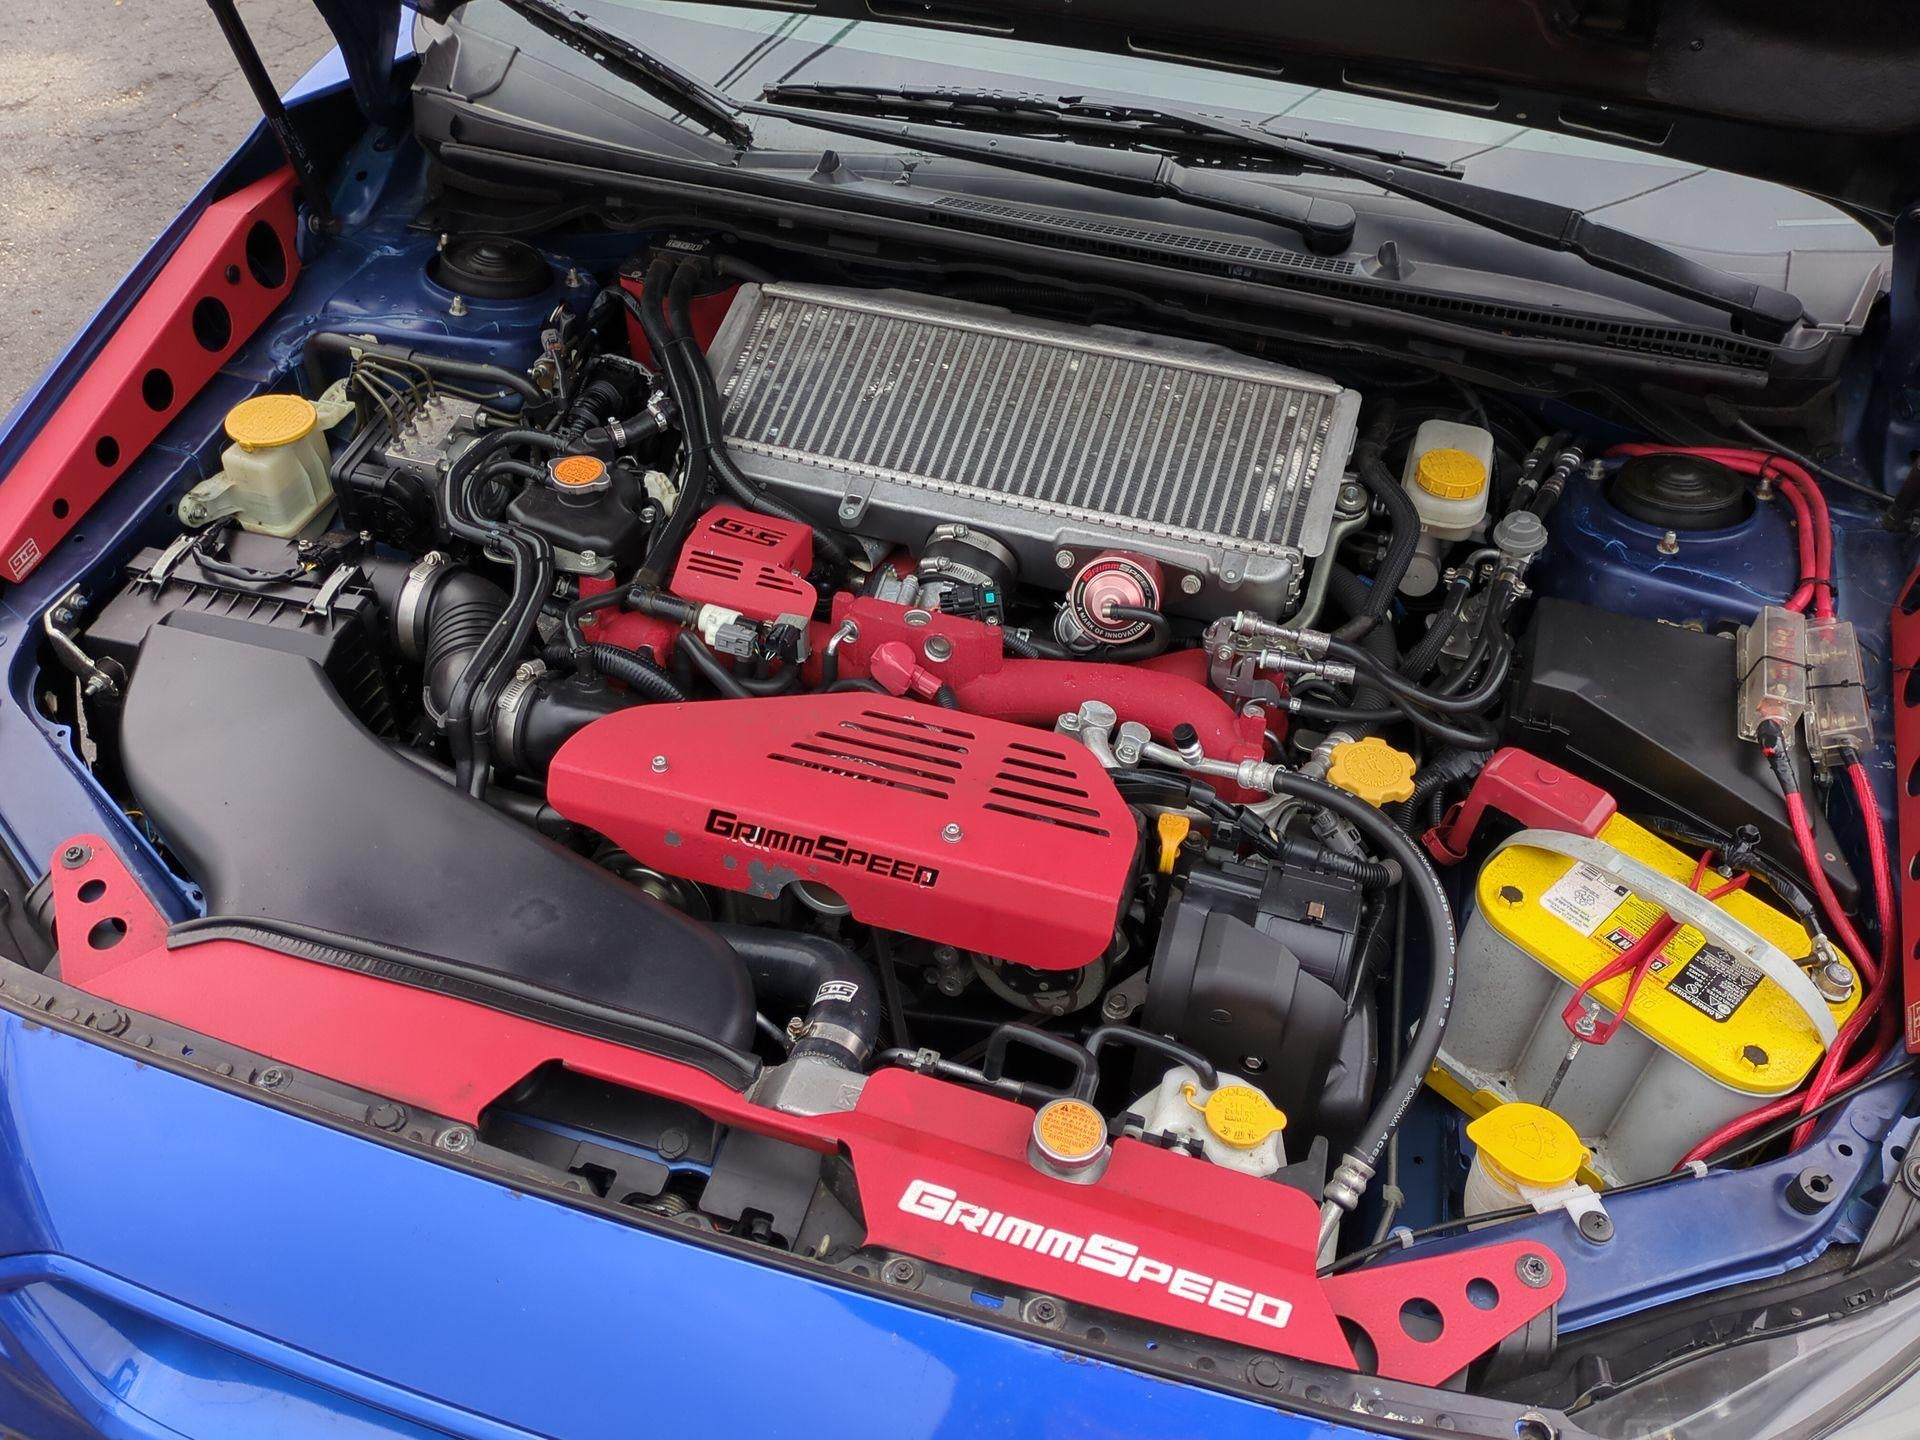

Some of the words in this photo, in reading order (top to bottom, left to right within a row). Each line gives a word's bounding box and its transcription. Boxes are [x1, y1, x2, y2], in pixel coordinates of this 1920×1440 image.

[1079, 613, 1095, 631] MARK
[1105, 621, 1146, 639] INNOVATION
[1448, 966, 1455, 986] AC
[1668, 983, 1715, 1016] DANGER/POISON
[1389, 1087, 1416, 1127] YOKOHAMA
